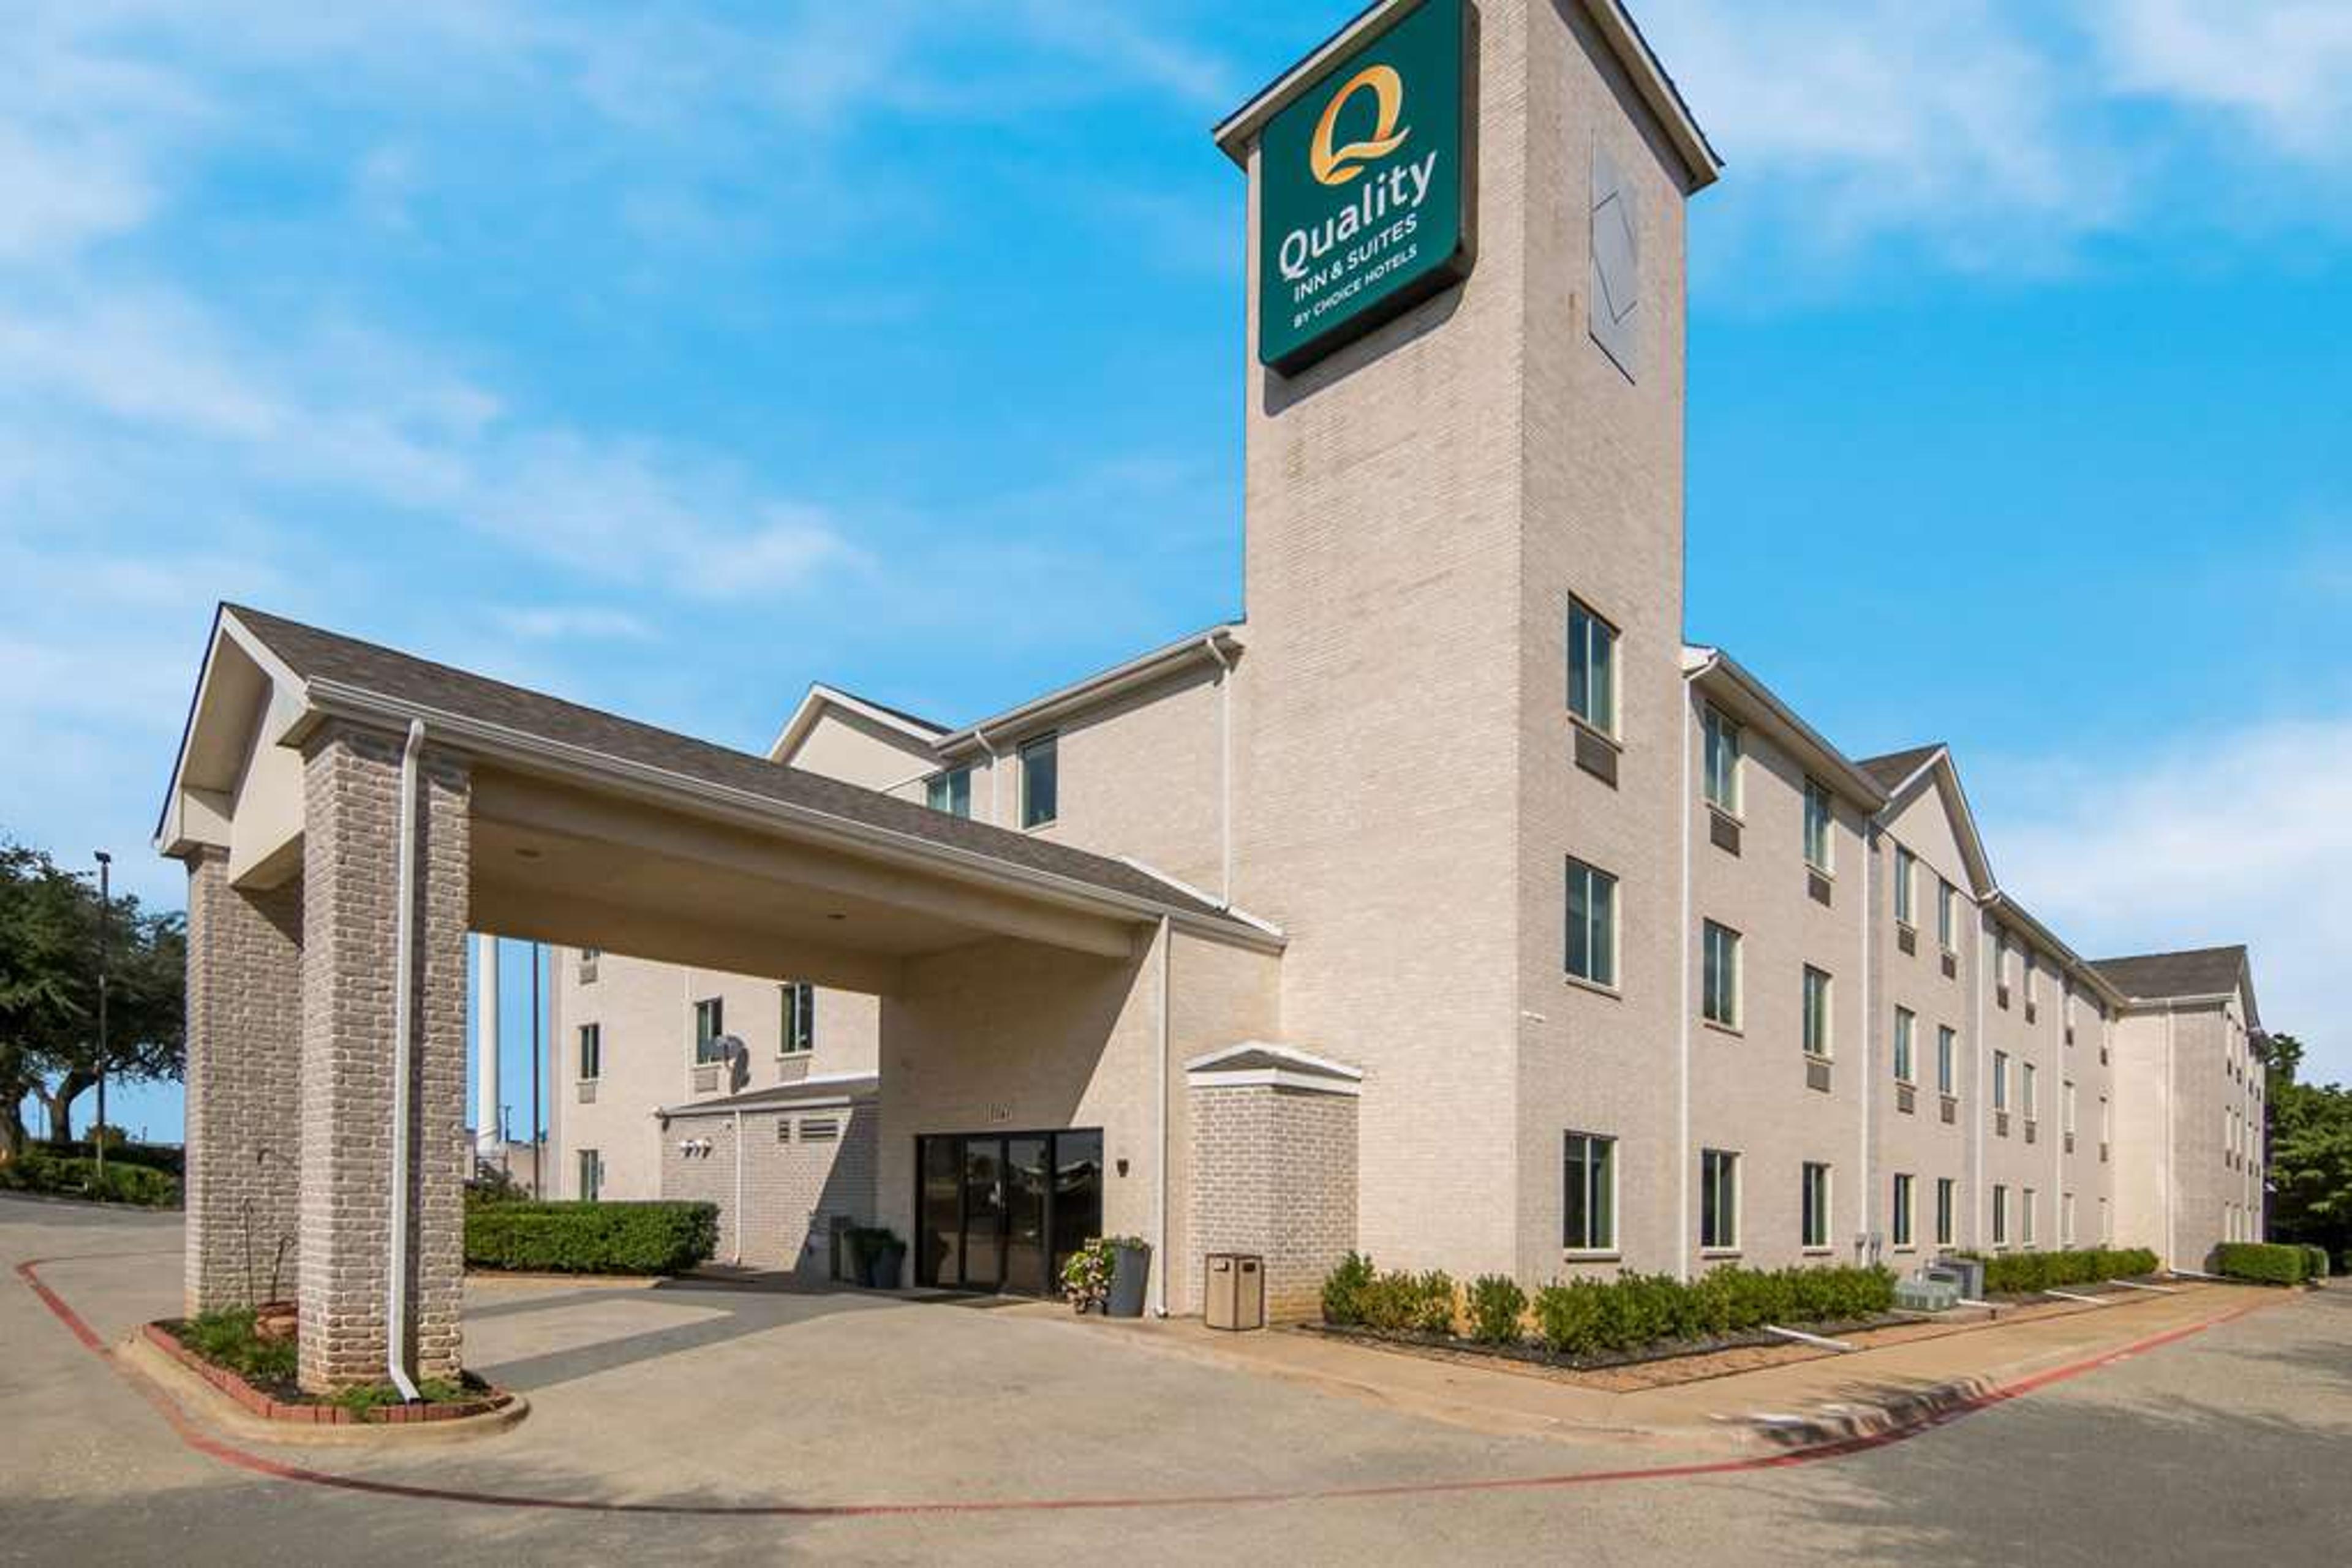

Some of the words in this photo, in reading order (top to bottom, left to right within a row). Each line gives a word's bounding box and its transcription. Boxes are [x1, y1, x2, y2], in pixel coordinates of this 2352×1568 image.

[1310, 64, 1411, 184] Q
[1280, 151, 1438, 281] Quality
[1294, 270, 1327, 302] INN
[1331, 260, 1343, 279] &
[1347, 213, 1417, 270] SUITES
[1294, 310, 1311, 329] BY
[1313, 279, 1362, 316] CHOICE
[1365, 244, 1417, 286] HOTELS
